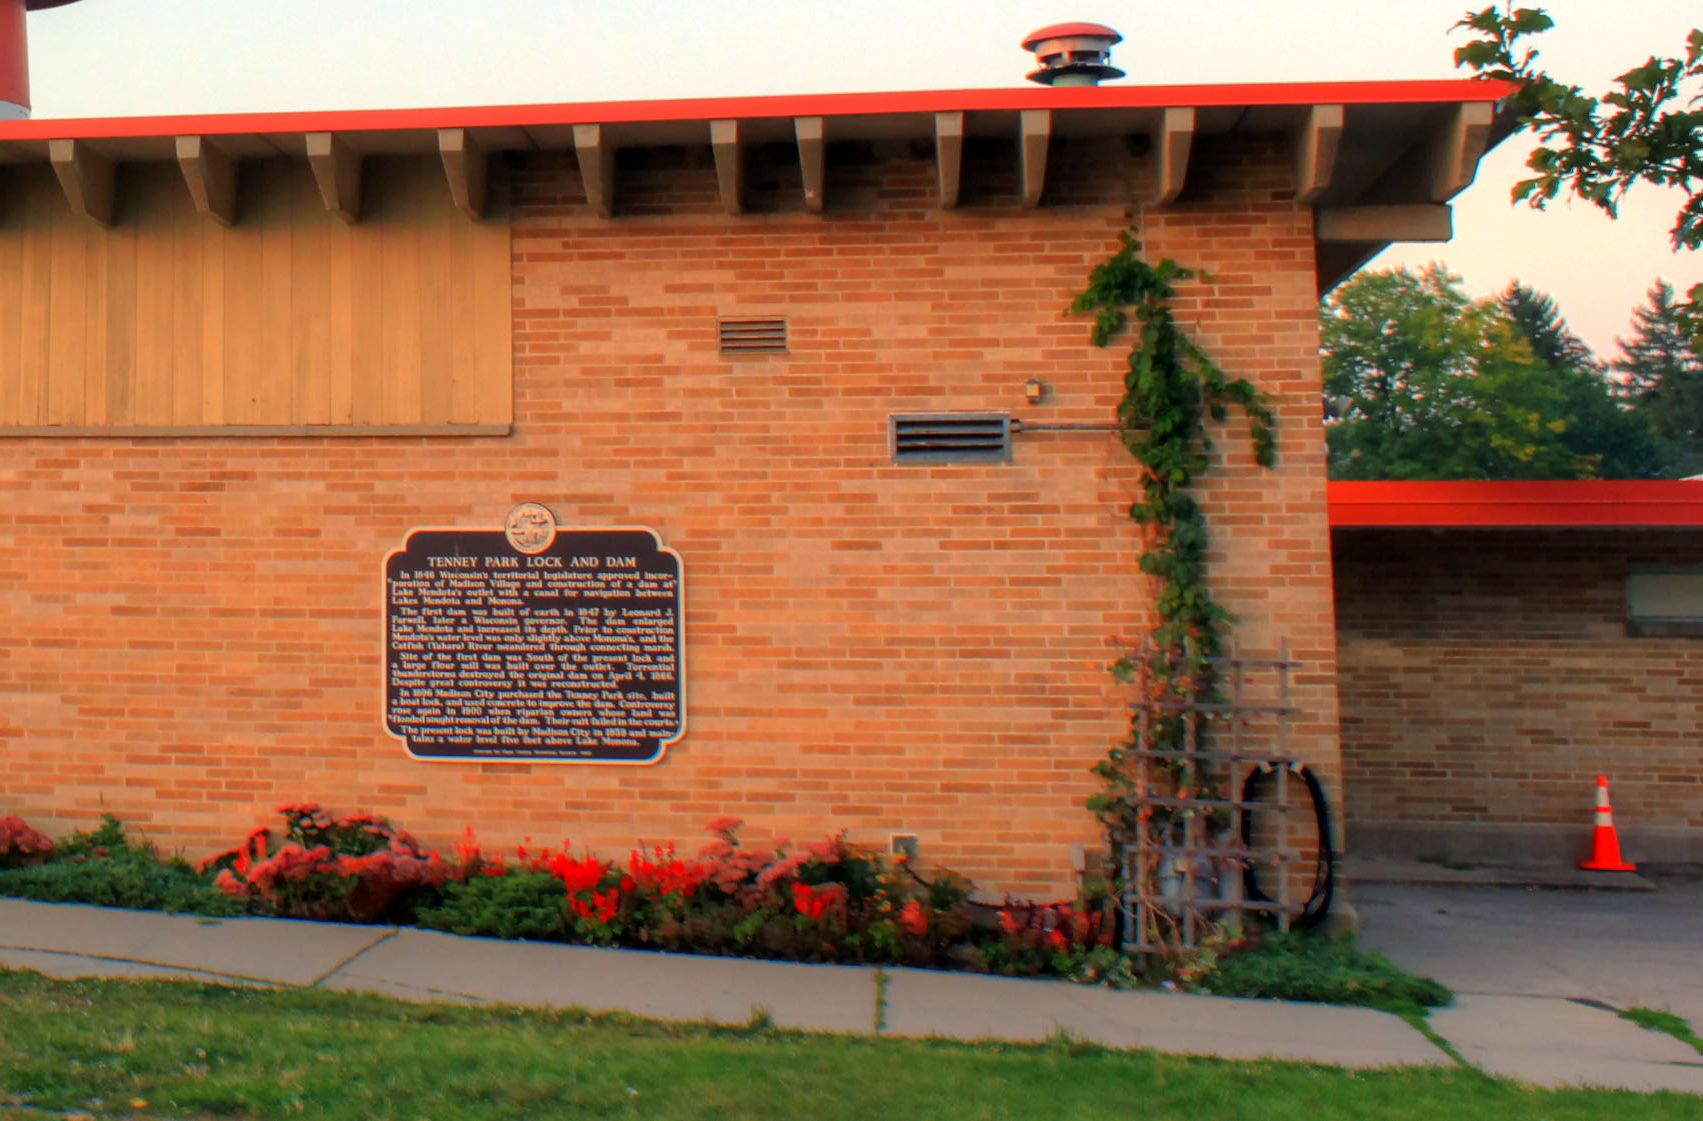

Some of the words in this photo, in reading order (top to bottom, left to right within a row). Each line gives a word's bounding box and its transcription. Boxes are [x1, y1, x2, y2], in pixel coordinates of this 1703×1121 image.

[427, 557, 477, 567] TENNEY
[485, 557, 519, 567] PARK
[527, 557, 563, 567] LOCK
[570, 557, 599, 567] AND
[606, 557, 637, 567] DAM
[400, 571, 409, 580] In
[493, 571, 539, 579] territorial
[543, 571, 592, 580] legislature
[597, 571, 640, 580] approved
[393, 580, 430, 589] poration
[435, 580, 445, 588] of
[450, 580, 485, 588] Madison
[490, 580, 521, 589] Village
[525, 580, 542, 588] and
[547, 580, 605, 588] construction
[610, 580, 622, 588] of
[637, 580, 658, 588] dam
[663, 580, 673, 588] at
[392, 589, 414, 597] Lake
[466, 589, 493, 597] outlet
[498, 589, 518, 597] with
[534, 589, 558, 597] canal
[564, 589, 578, 597] for
[583, 589, 630, 598] navigation
[635, 589, 673, 597] between
[392, 596, 418, 605] Lakes
[423, 596, 460, 605] Mendota
[465, 596, 482, 605] and
[400, 608, 418, 616] The
[422, 608, 442, 616] first
[447, 608, 466, 616] dam
[492, 608, 514, 616] built
[519, 608, 530, 616] of
[534, 608, 560, 616] earth
[564, 608, 574, 616] in
[603, 608, 616, 618] by
[622, 608, 661, 616] Leonard
[433, 616, 455, 624] later
[473, 616, 518, 624] Wisconsin
[580, 616, 598, 625] The
[604, 616, 626, 625] dam
[392, 624, 413, 633] Lake
[417, 624, 453, 633] Mendota
[457, 625, 474, 633] and
[524, 625, 536, 634] its
[573, 625, 598, 634] Prior
[603, 625, 613, 634] to
[616, 625, 674, 634] construction
[436, 633, 460, 642] water
[463, 633, 483, 642] level
[504, 634, 524, 643] only
[564, 634, 590, 642] above
[639, 634, 656, 643] and
[659, 634, 674, 643] the
[392, 642, 424, 650] Catfish
[468, 642, 493, 651] River
[550, 643, 586, 653] through
[590, 643, 640, 653] connecting
[400, 653, 418, 661] Site
[422, 653, 433, 661] of
[437, 653, 451, 661] the
[456, 653, 477, 661] first
[481, 653, 501, 661] dam
[526, 653, 554, 662] South
[558, 653, 568, 662] of
[572, 653, 588, 662] the
[592, 653, 628, 663] present
[632, 653, 652, 662] lock
[656, 653, 674, 662] and
[431, 662, 454, 670] flour
[460, 662, 479, 670] mill
[506, 662, 529, 670] built
[561, 662, 577, 671] the
[626, 662, 674, 671] Torrential
[459, 671, 505, 680] destroyed
[509, 671, 524, 679] the
[568, 671, 587, 680] dam
[608, 671, 632, 681] April
[392, 678, 426, 687] Despite
[429, 678, 454, 688] great
[458, 679, 513, 688] controversy
[518, 679, 526, 687] it
[400, 689, 409, 697] In
[436, 689, 472, 698] Madison
[475, 689, 494, 699] City
[498, 690, 543, 700] purchased
[546, 690, 562, 699] the
[601, 690, 623, 699] Park
[651, 690, 675, 699] built
[400, 698, 420, 706] boat
[446, 698, 462, 706] and
[465, 698, 485, 706] used
[487, 698, 526, 707] concrete
[528, 699, 537, 707] to
[540, 699, 574, 708] improve
[577, 699, 592, 707] the
[618, 699, 674, 709] Controversy
[417, 707, 441, 716] again
[446, 707, 456, 715] in
[488, 708, 511, 716] when
[631, 708, 652, 717] land
[456, 715, 489, 724] removal
[491, 716, 500, 724] of
[503, 716, 518, 724] the
[401, 726, 419, 734] The
[420, 726, 453, 736] present
[456, 726, 474, 735] lock
[494, 726, 515, 735] built
[517, 727, 530, 737] by
[532, 727, 568, 736] Madison
[570, 727, 590, 737] City
[593, 727, 603, 736] in
[629, 728, 646, 737] and
[447, 736, 472, 744] water
[476, 736, 497, 744] level
[545, 736, 572, 745] above
[575, 737, 598, 745] Lake
